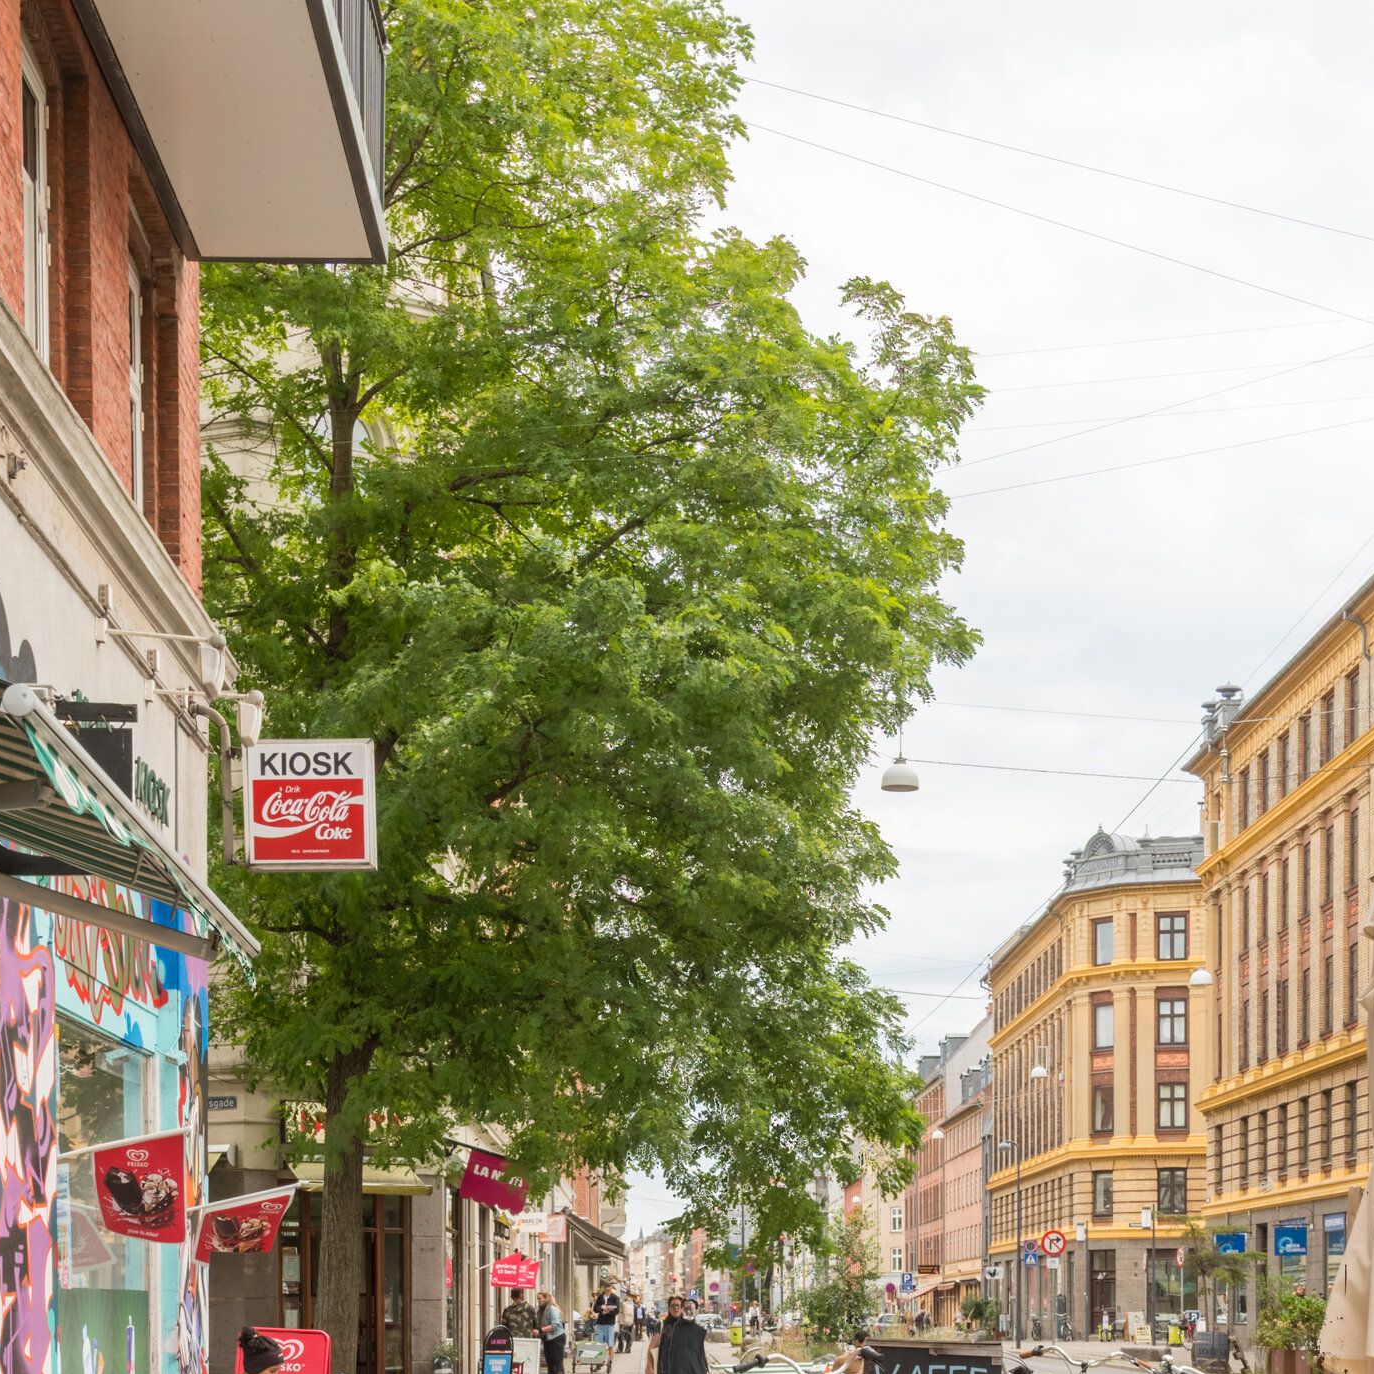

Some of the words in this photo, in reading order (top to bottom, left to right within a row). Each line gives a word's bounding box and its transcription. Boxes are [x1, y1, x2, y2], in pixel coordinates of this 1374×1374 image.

[260, 751, 354, 776] KIOSK
[285, 785, 301, 794] Drik
[262, 790, 353, 823] Coca-Cola
[315, 823, 353, 840] Coke
[208, 1099, 235, 1110] sgade
[473, 1164, 489, 1178] LA
[280, 1363, 301, 1372] SKO
